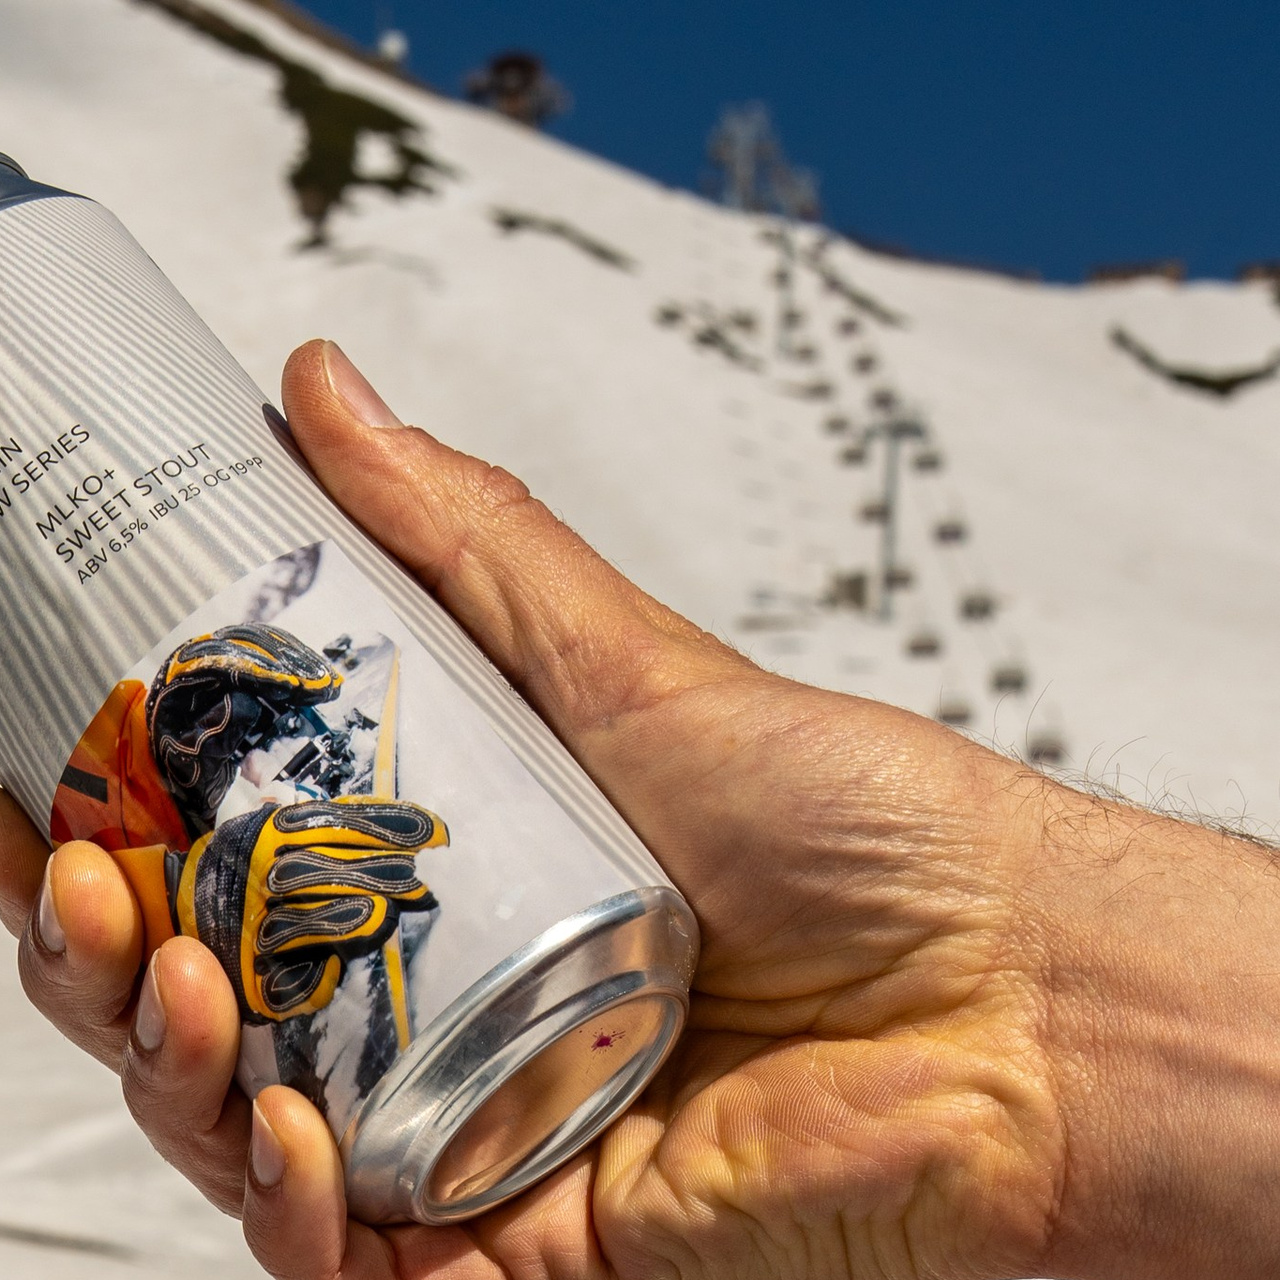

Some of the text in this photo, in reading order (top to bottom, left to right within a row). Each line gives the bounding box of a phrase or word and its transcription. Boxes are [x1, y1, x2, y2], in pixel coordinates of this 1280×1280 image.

[16, 424, 91, 494] SERIES
[35, 468, 116, 540] MLKO+
[56, 443, 211, 563] SWEET STOUT
[77, 548, 108, 584] ABV
[109, 518, 148, 553] 6,5%
[149, 495, 179, 521] IBU
[178, 483, 201, 502] 25
[203, 468, 231, 487] OG
